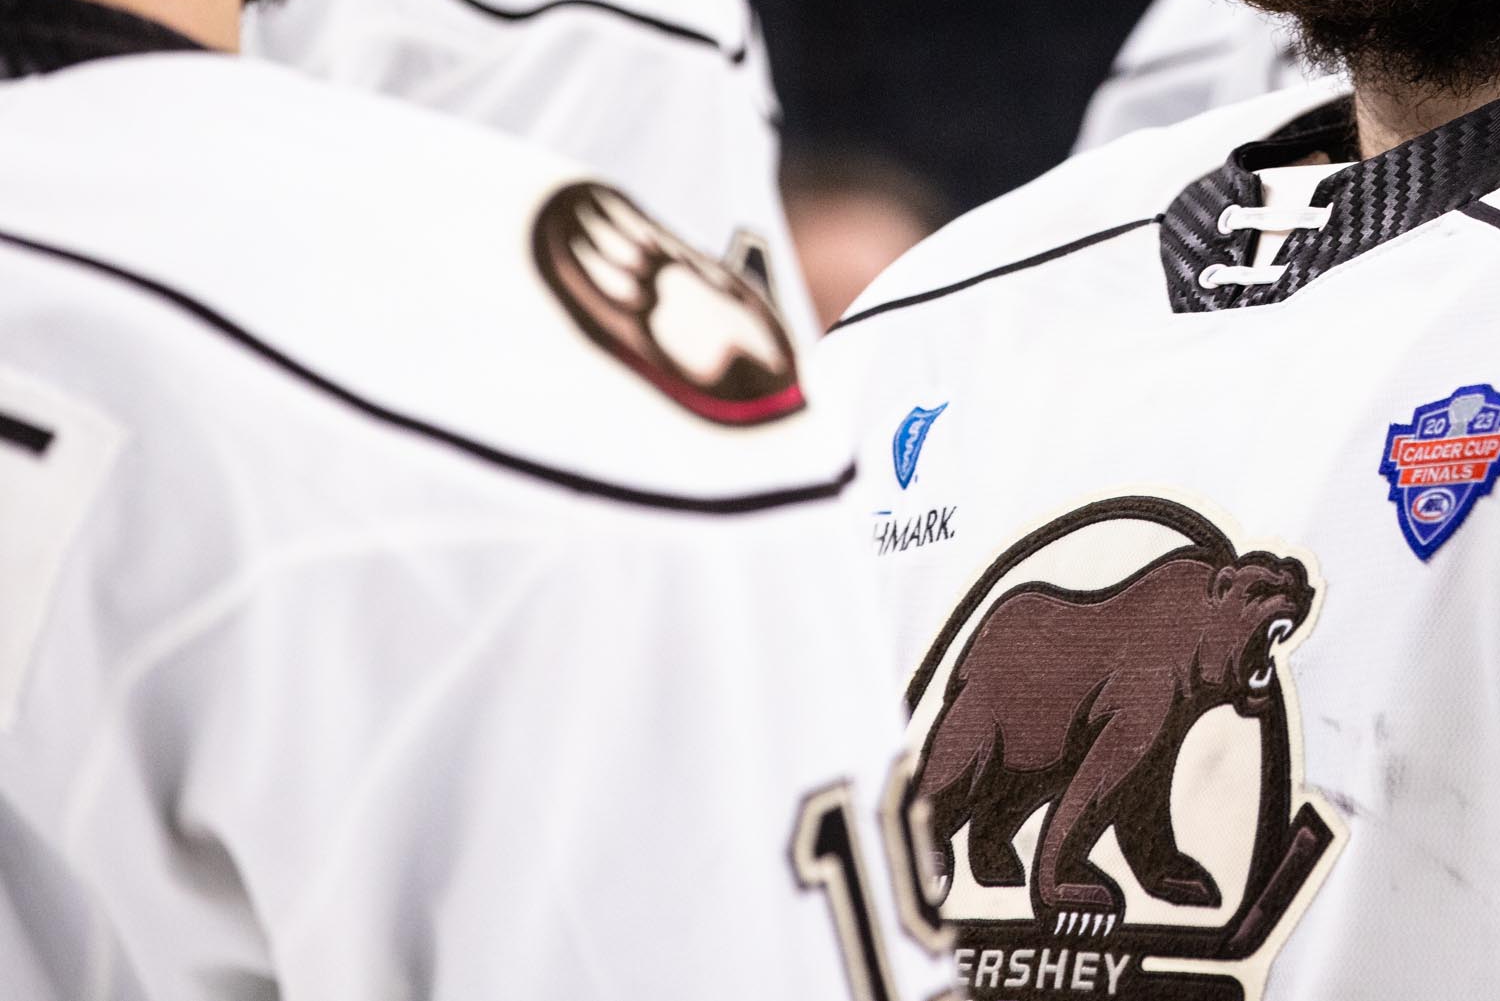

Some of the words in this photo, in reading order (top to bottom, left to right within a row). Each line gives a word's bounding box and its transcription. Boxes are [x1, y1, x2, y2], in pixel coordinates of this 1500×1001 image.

[1424, 419, 1446, 435] 20
[1473, 412, 1495, 430] 23
[1403, 443, 1461, 462] CALDER
[1465, 439, 1499, 456] CUP
[1410, 464, 1474, 483] FINALS
[954, 947, 1131, 995] ERSHEY
